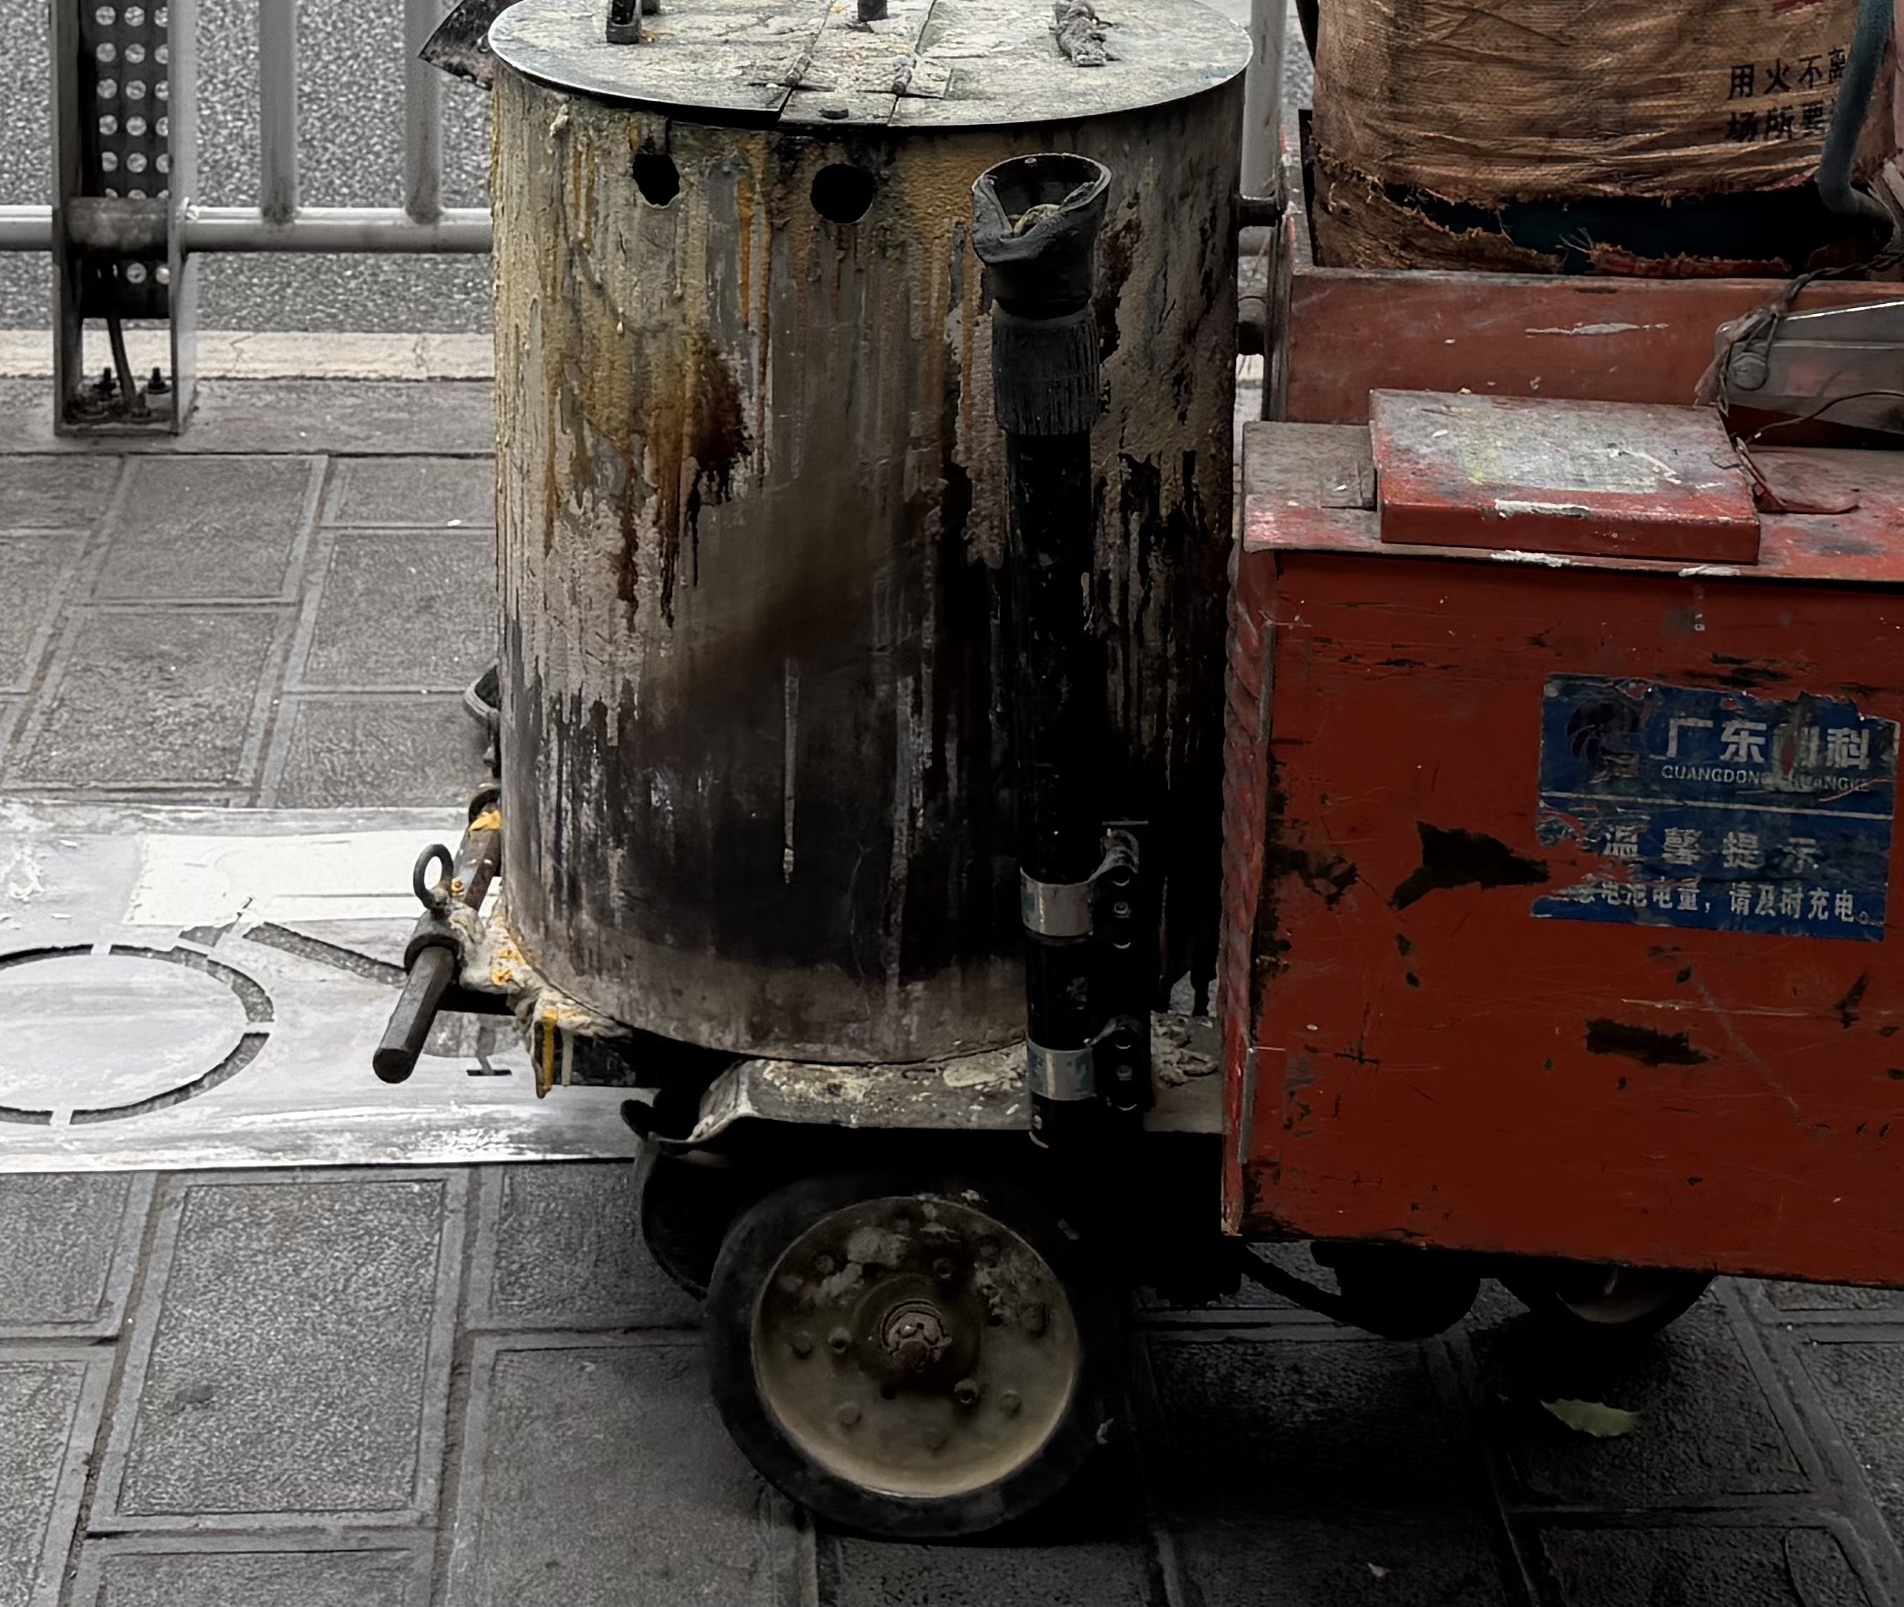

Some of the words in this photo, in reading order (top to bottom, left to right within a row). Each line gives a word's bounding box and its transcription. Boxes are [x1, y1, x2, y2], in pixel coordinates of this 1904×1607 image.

[1725, 97, 1837, 143] 场所要
[1601, 825, 1821, 874] 温馨提示
